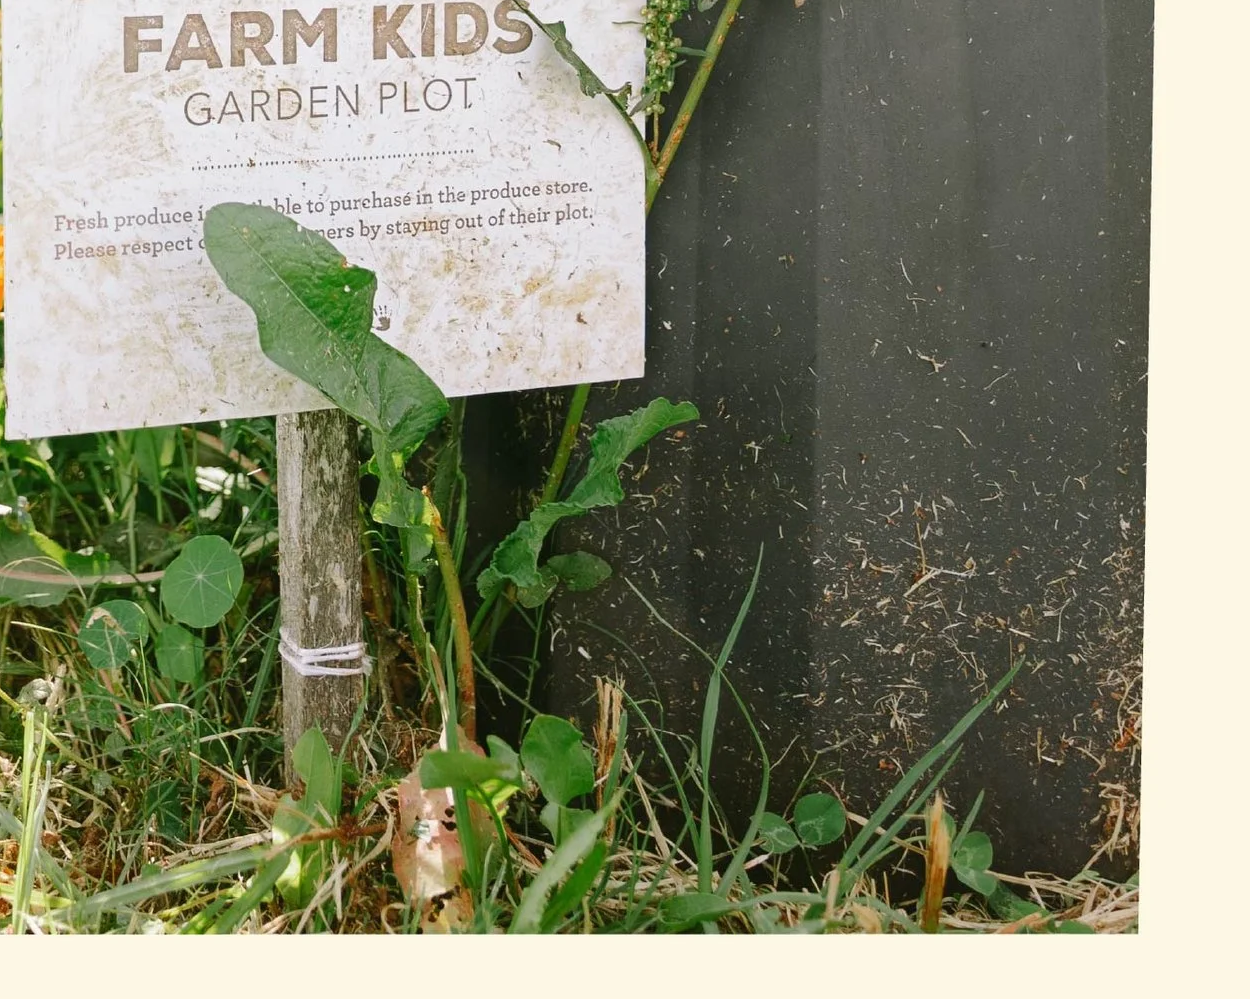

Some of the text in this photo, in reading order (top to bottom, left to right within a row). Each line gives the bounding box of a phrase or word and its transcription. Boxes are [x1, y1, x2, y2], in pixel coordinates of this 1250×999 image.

[123, 0, 534, 73] FARM KIDS
[183, 77, 477, 127] GARDEN PLOT
[54, 212, 108, 231] Fresh
[113, 207, 193, 231] produce
[306, 199, 325, 214] to
[330, 191, 411, 216] purchase
[416, 189, 433, 205] in
[438, 186, 466, 203] the
[470, 181, 541, 201] produce
[545, 179, 593, 196] store.
[54, 243, 117, 260] Please
[121, 236, 193, 257] respect
[359, 219, 380, 240] by
[386, 215, 450, 237] staying
[455, 211, 484, 229] out
[488, 208, 506, 226] of
[509, 205, 551, 224] their
[554, 203, 594, 225] plot.
